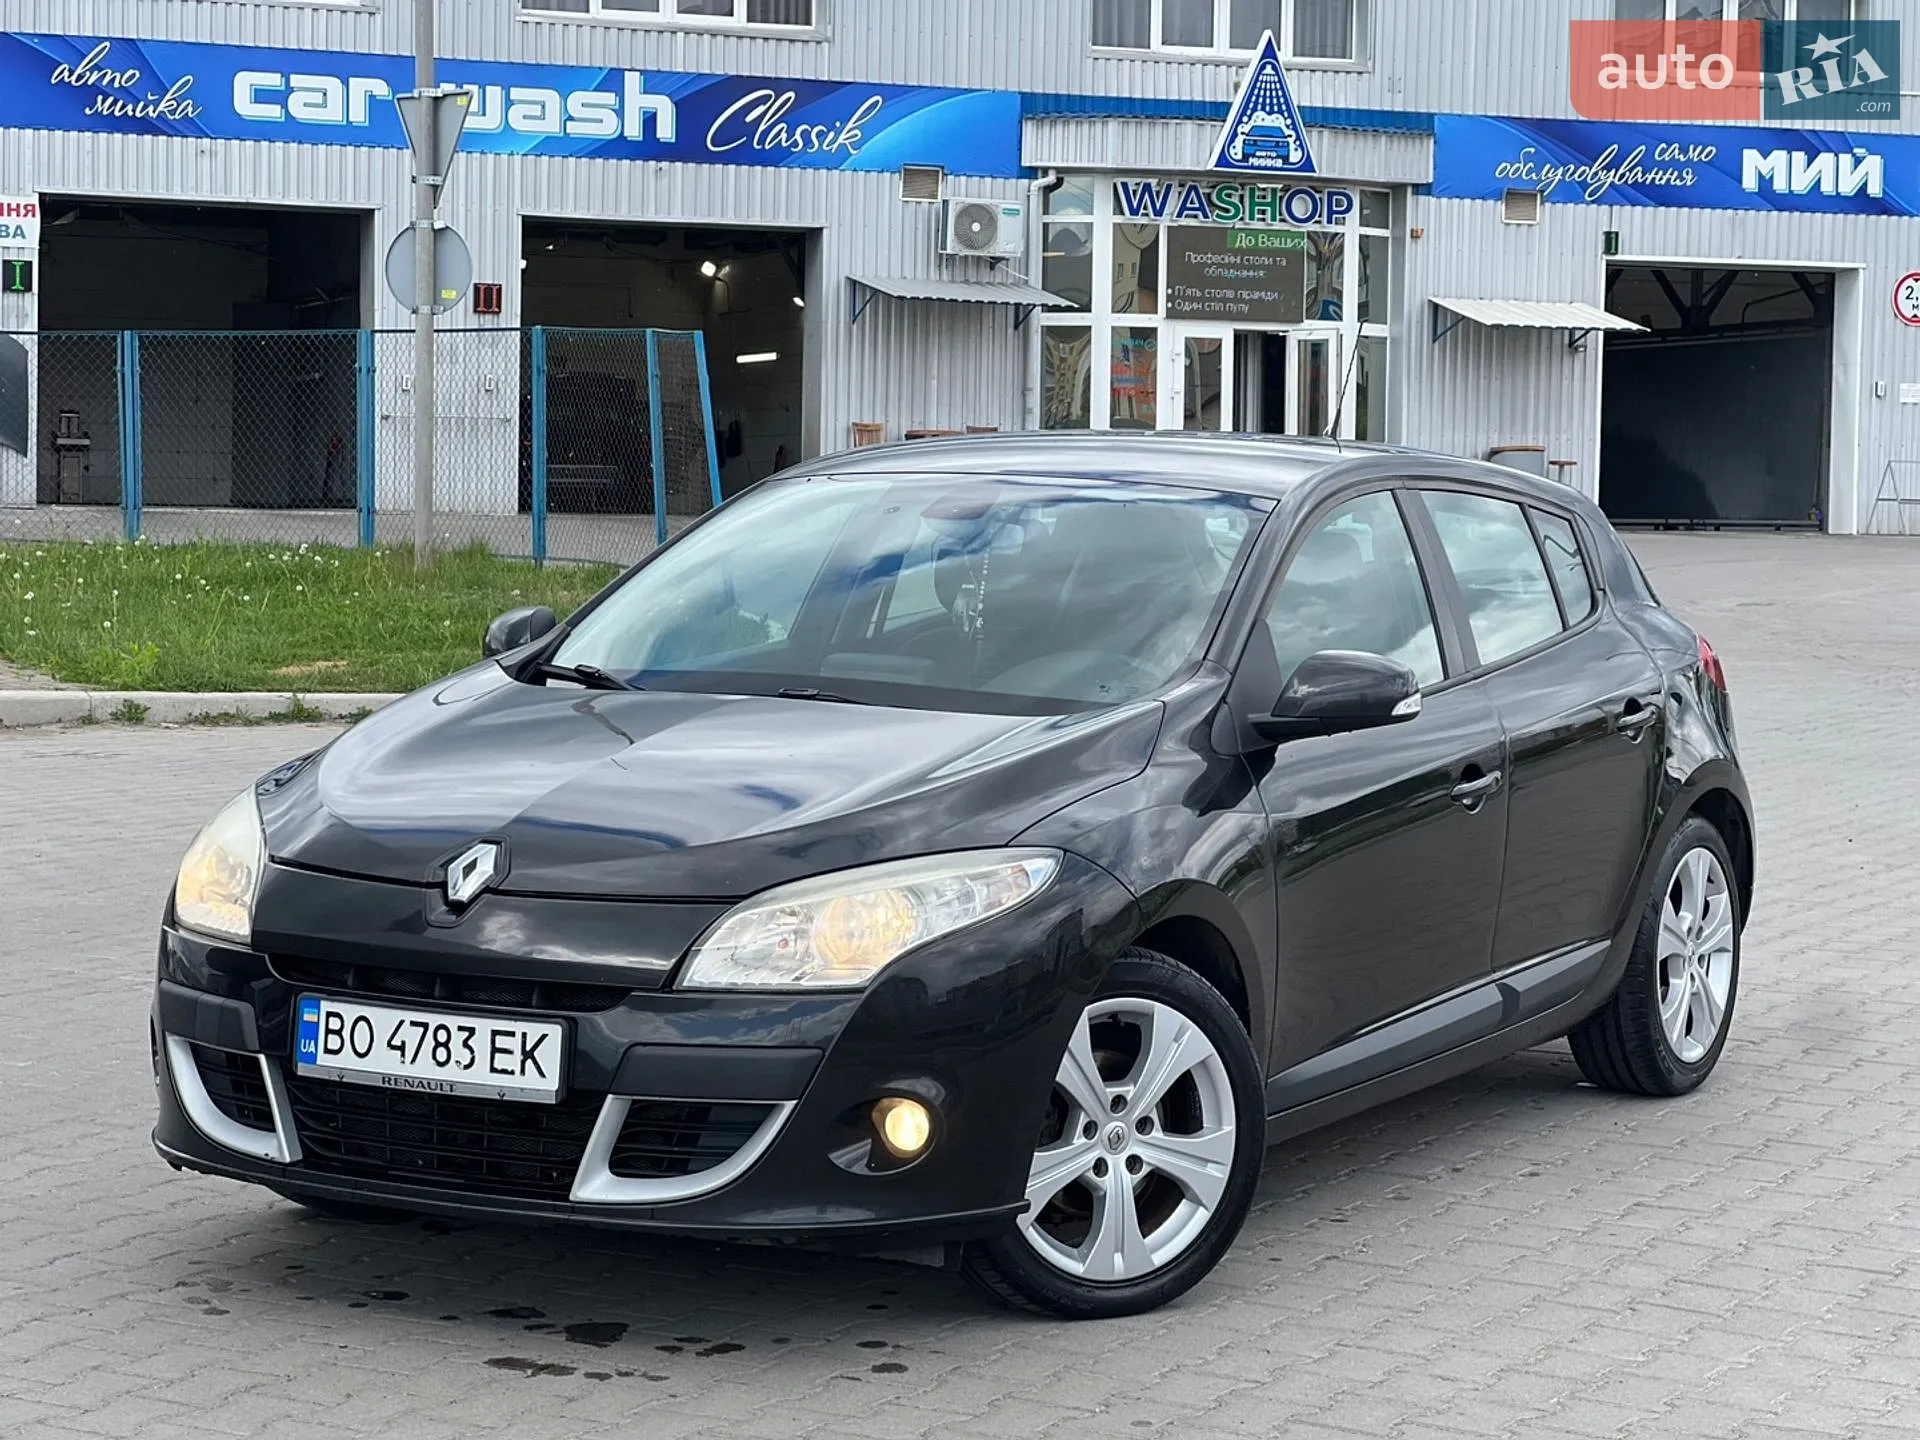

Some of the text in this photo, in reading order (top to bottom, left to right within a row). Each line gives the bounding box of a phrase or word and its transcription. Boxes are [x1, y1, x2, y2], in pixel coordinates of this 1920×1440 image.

[50, 41, 140, 88] авто
[84, 75, 203, 120] мийка
[233, 70, 392, 127] car
[705, 88, 883, 157] Classik
[1495, 142, 1697, 201] обслуговування
[1654, 142, 1717, 162] само
[1740, 147, 1885, 197] МИЙ
[1118, 180, 1356, 226] WASHOP
[1235, 232, 1307, 248] До Ваших
[301, 1039, 316, 1055] UA
[322, 1010, 549, 1079] BO 4783 EK
[381, 1075, 457, 1094] RENAULT
